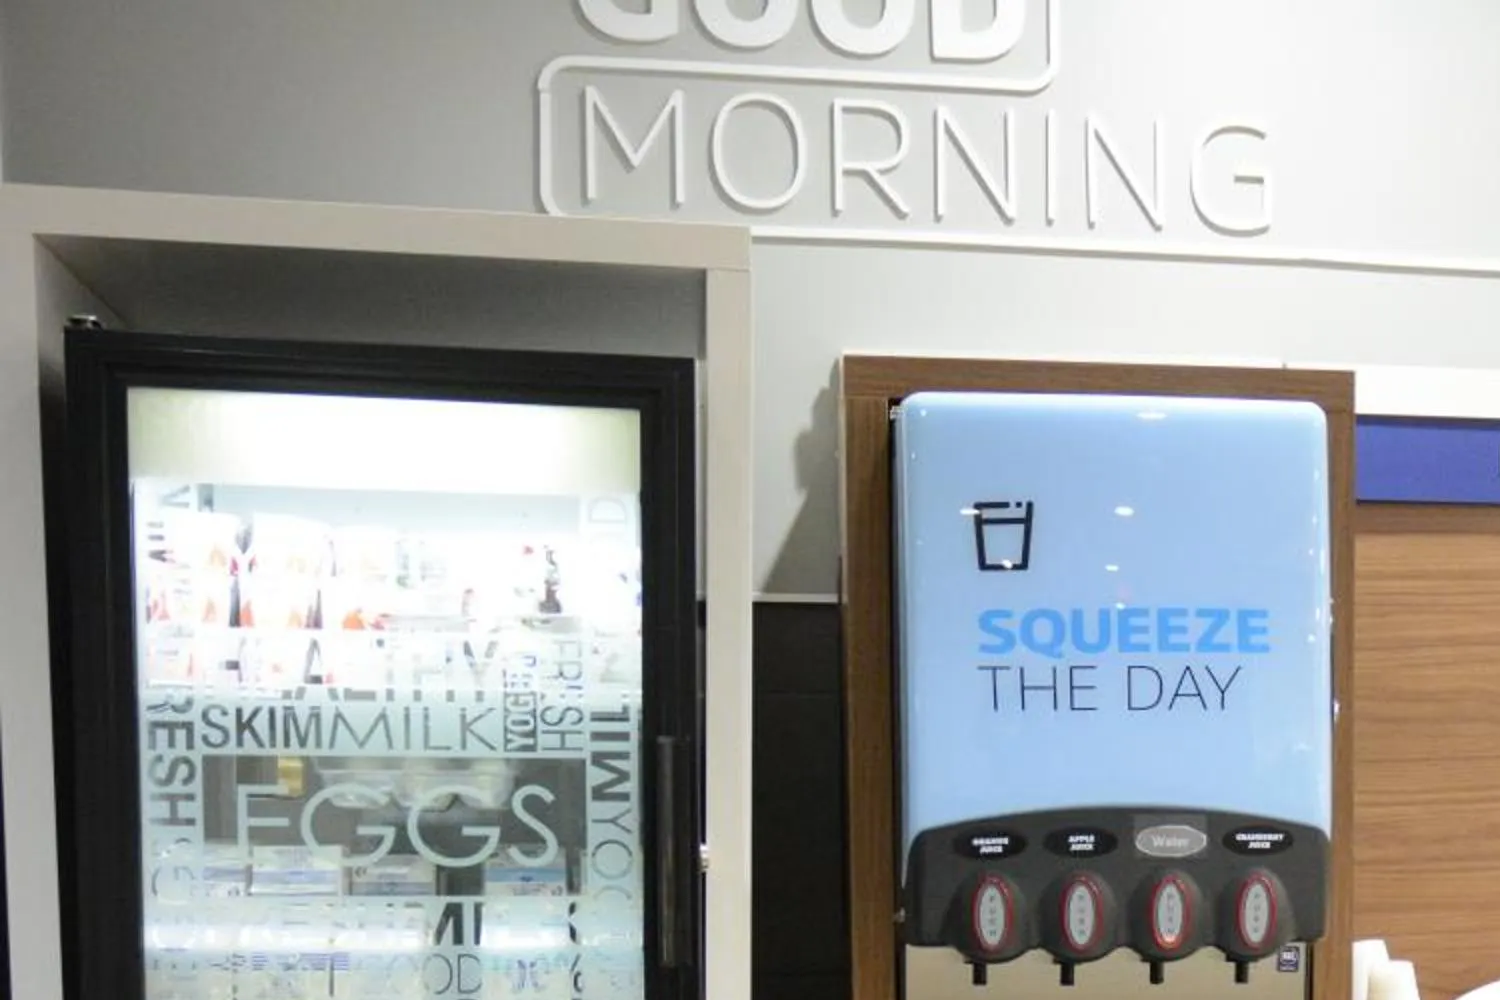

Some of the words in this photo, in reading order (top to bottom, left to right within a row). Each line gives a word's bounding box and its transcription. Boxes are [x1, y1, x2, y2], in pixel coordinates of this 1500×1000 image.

[581, 84, 1273, 237] MORNING
[977, 607, 1271, 658] SQUEEZE
[977, 665, 1098, 711] THE
[1127, 665, 1242, 711] DAY
[201, 703, 323, 749] SKIM
[329, 703, 498, 752] MILK
[237, 783, 559, 868] EGGS
[1151, 834, 1191, 849] Water
